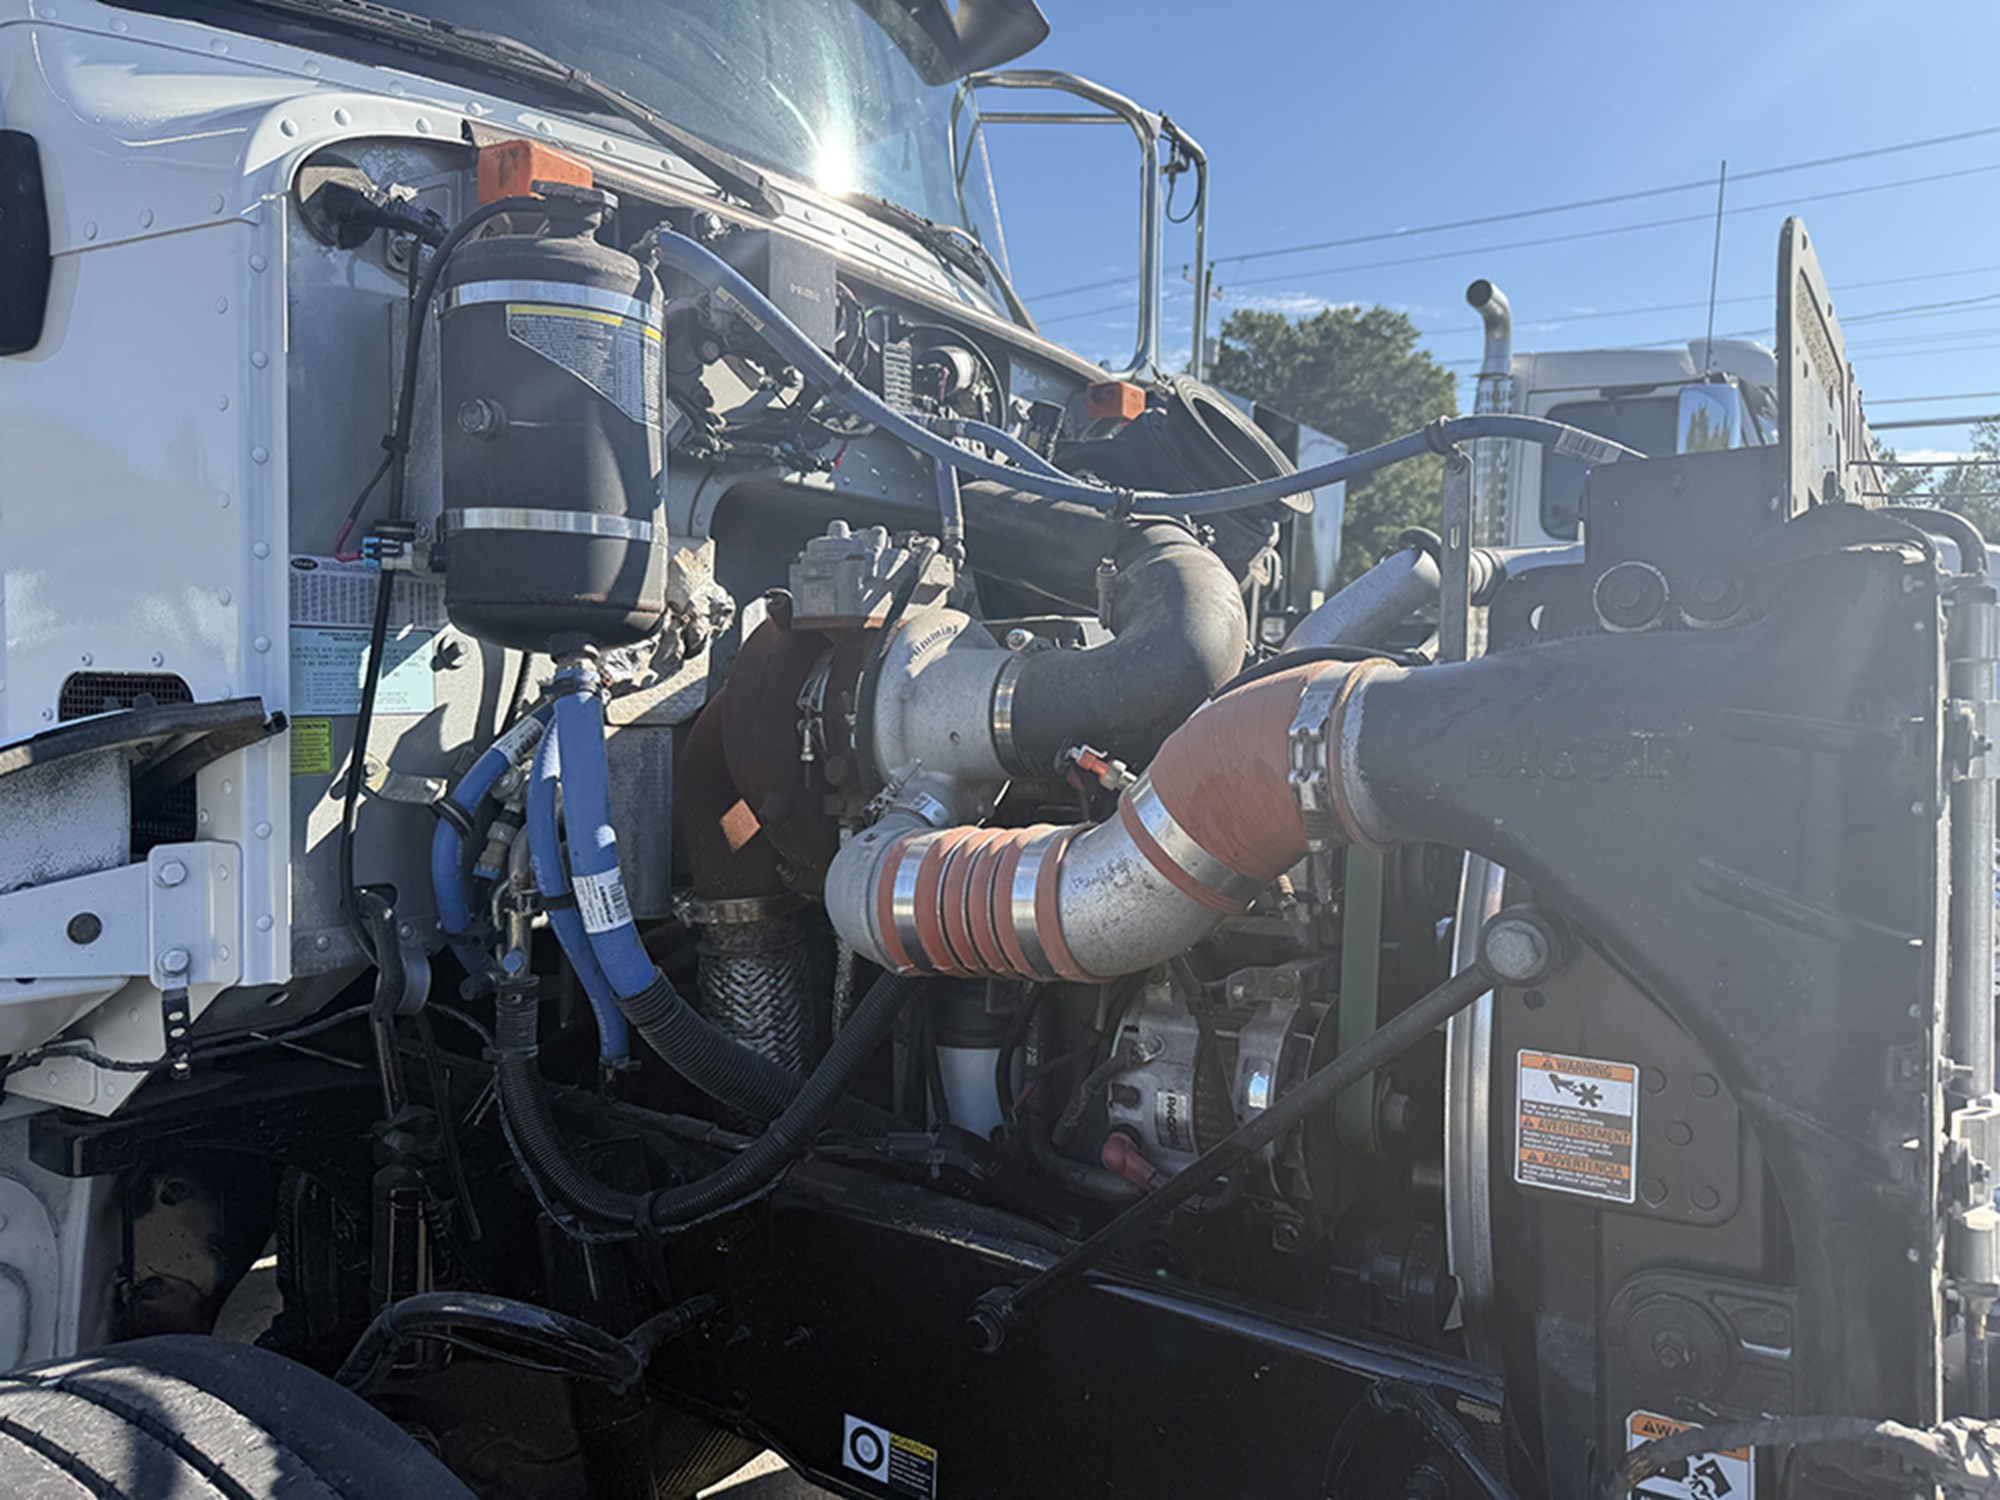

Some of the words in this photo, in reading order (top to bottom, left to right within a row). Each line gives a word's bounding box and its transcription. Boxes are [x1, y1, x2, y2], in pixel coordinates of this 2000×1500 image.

[1467, 736, 1692, 781] PACCAR
[1557, 1060, 1612, 1078] WARNING
[1538, 1120, 1629, 1143] AVERTISSEMENT
[1542, 1153, 1624, 1177] ADVERTENCIA
